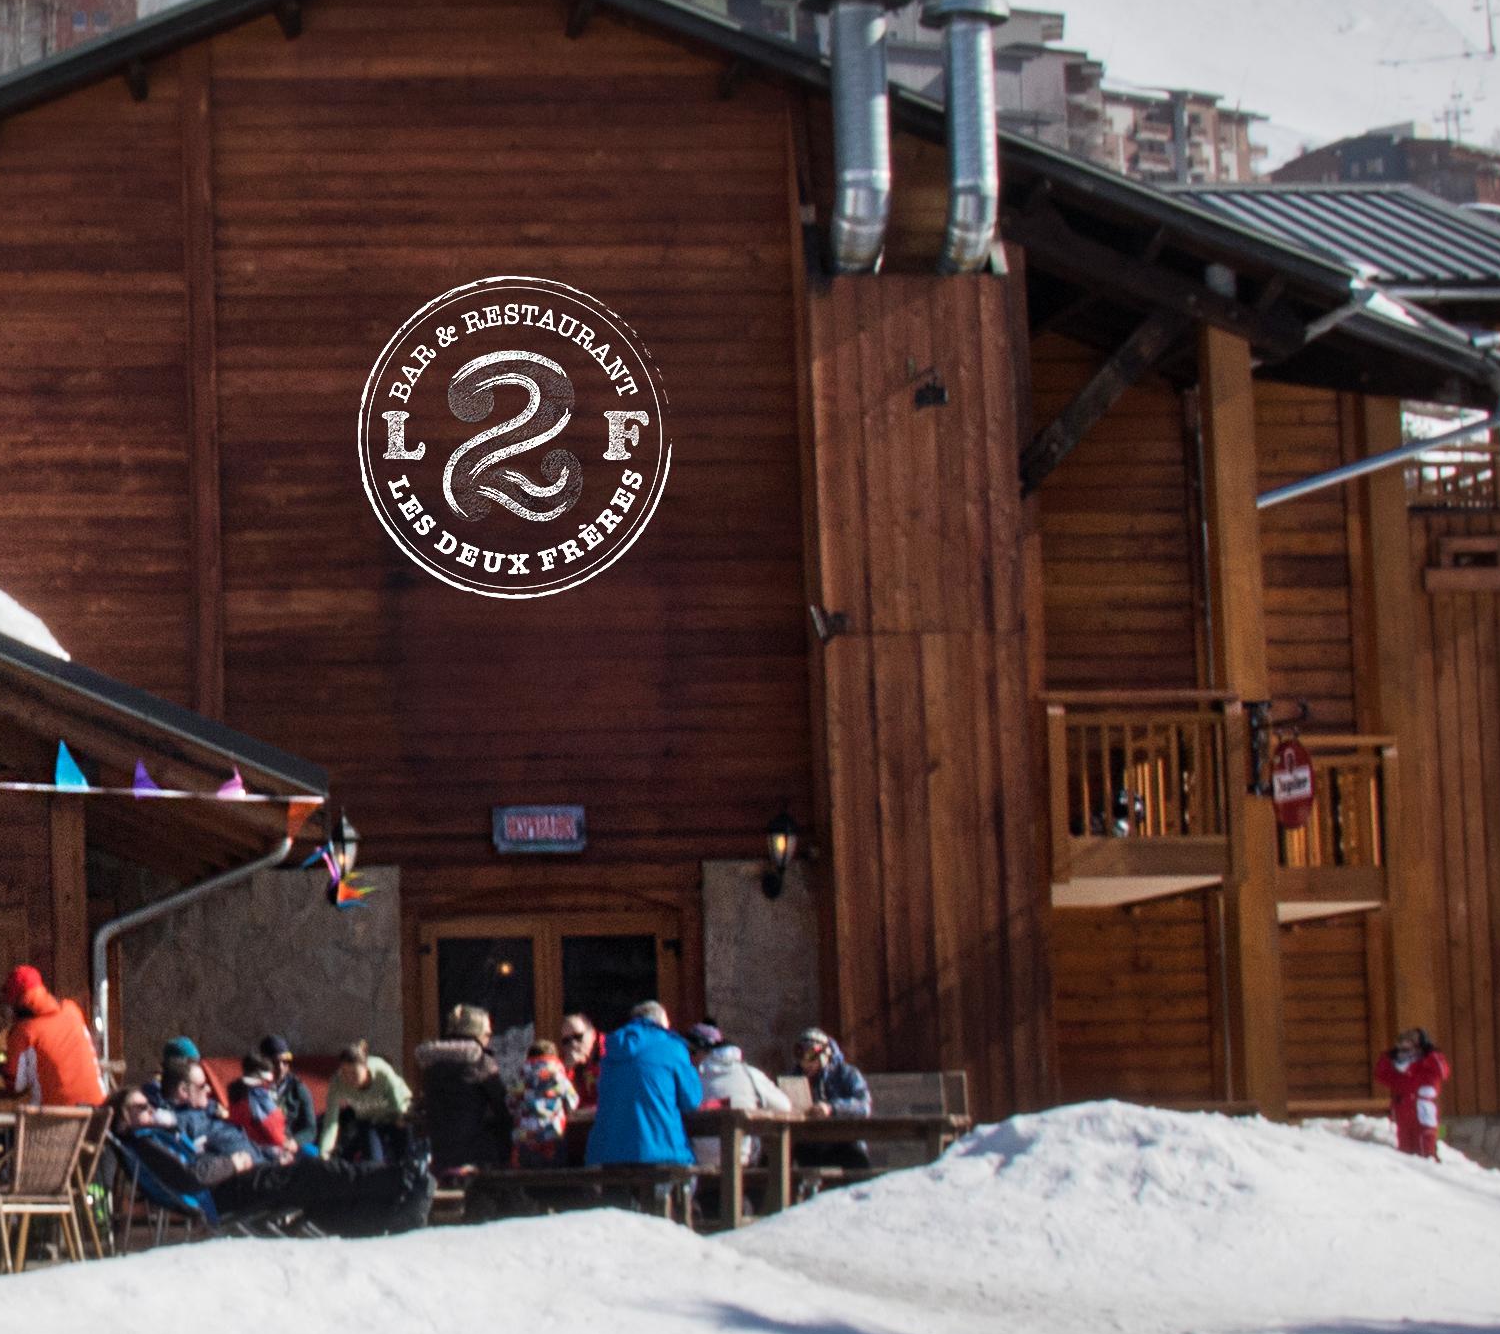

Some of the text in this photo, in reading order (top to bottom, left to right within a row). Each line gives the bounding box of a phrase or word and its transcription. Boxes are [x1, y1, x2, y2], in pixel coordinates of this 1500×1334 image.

[389, 303, 639, 404] BAR & RESTAURANT
[381, 350, 650, 522] L 2 F
[388, 469, 643, 575] LES DEUX FRÈRES
